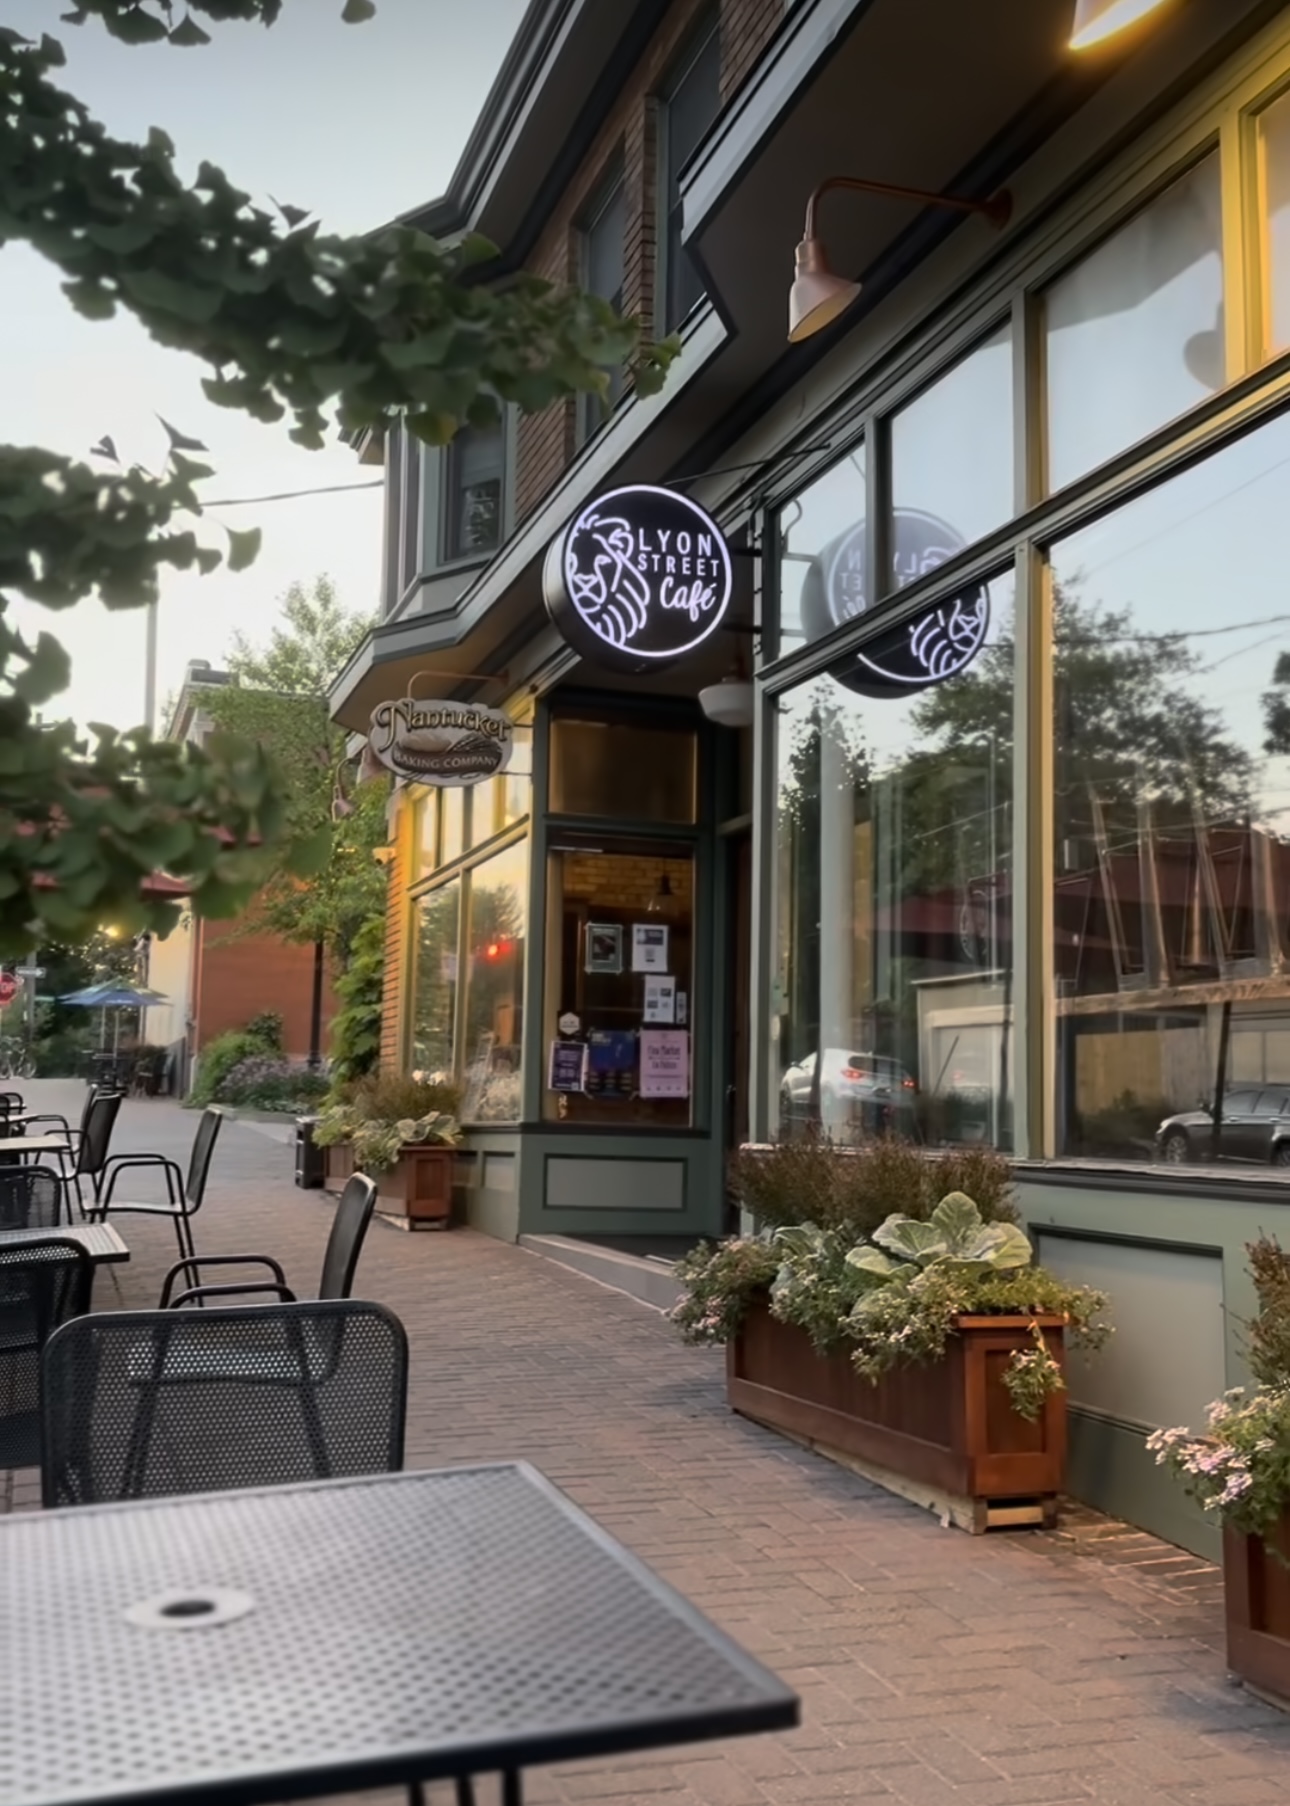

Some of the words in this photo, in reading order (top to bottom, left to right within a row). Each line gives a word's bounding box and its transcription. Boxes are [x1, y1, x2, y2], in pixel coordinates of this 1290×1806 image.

[638, 527, 712, 557] LYON
[637, 553, 720, 577] STREET
[660, 576, 717, 622] Café
[375, 701, 509, 753] Nantucket
[394, 752, 439, 769] BAKING
[442, 755, 498, 769] COMPANY
